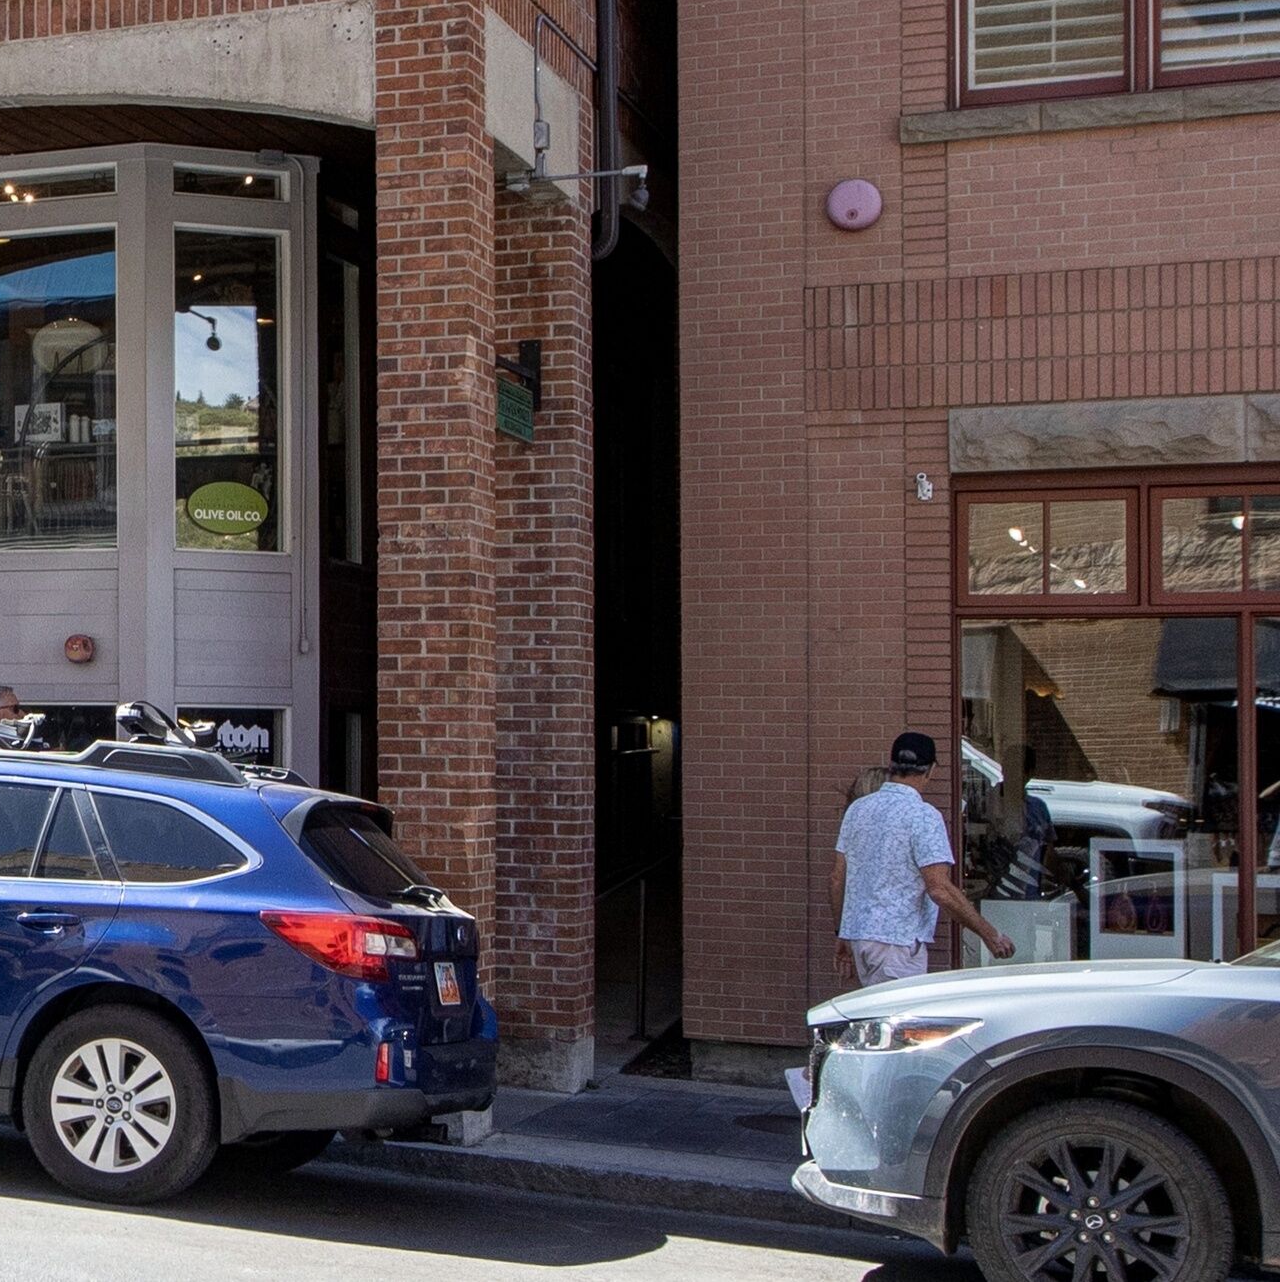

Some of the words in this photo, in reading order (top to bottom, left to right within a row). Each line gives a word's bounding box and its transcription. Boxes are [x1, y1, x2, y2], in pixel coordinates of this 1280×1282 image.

[194, 509, 225, 520] OLIVE
[226, 510, 244, 521] OIL
[244, 511, 262, 522] CO.
